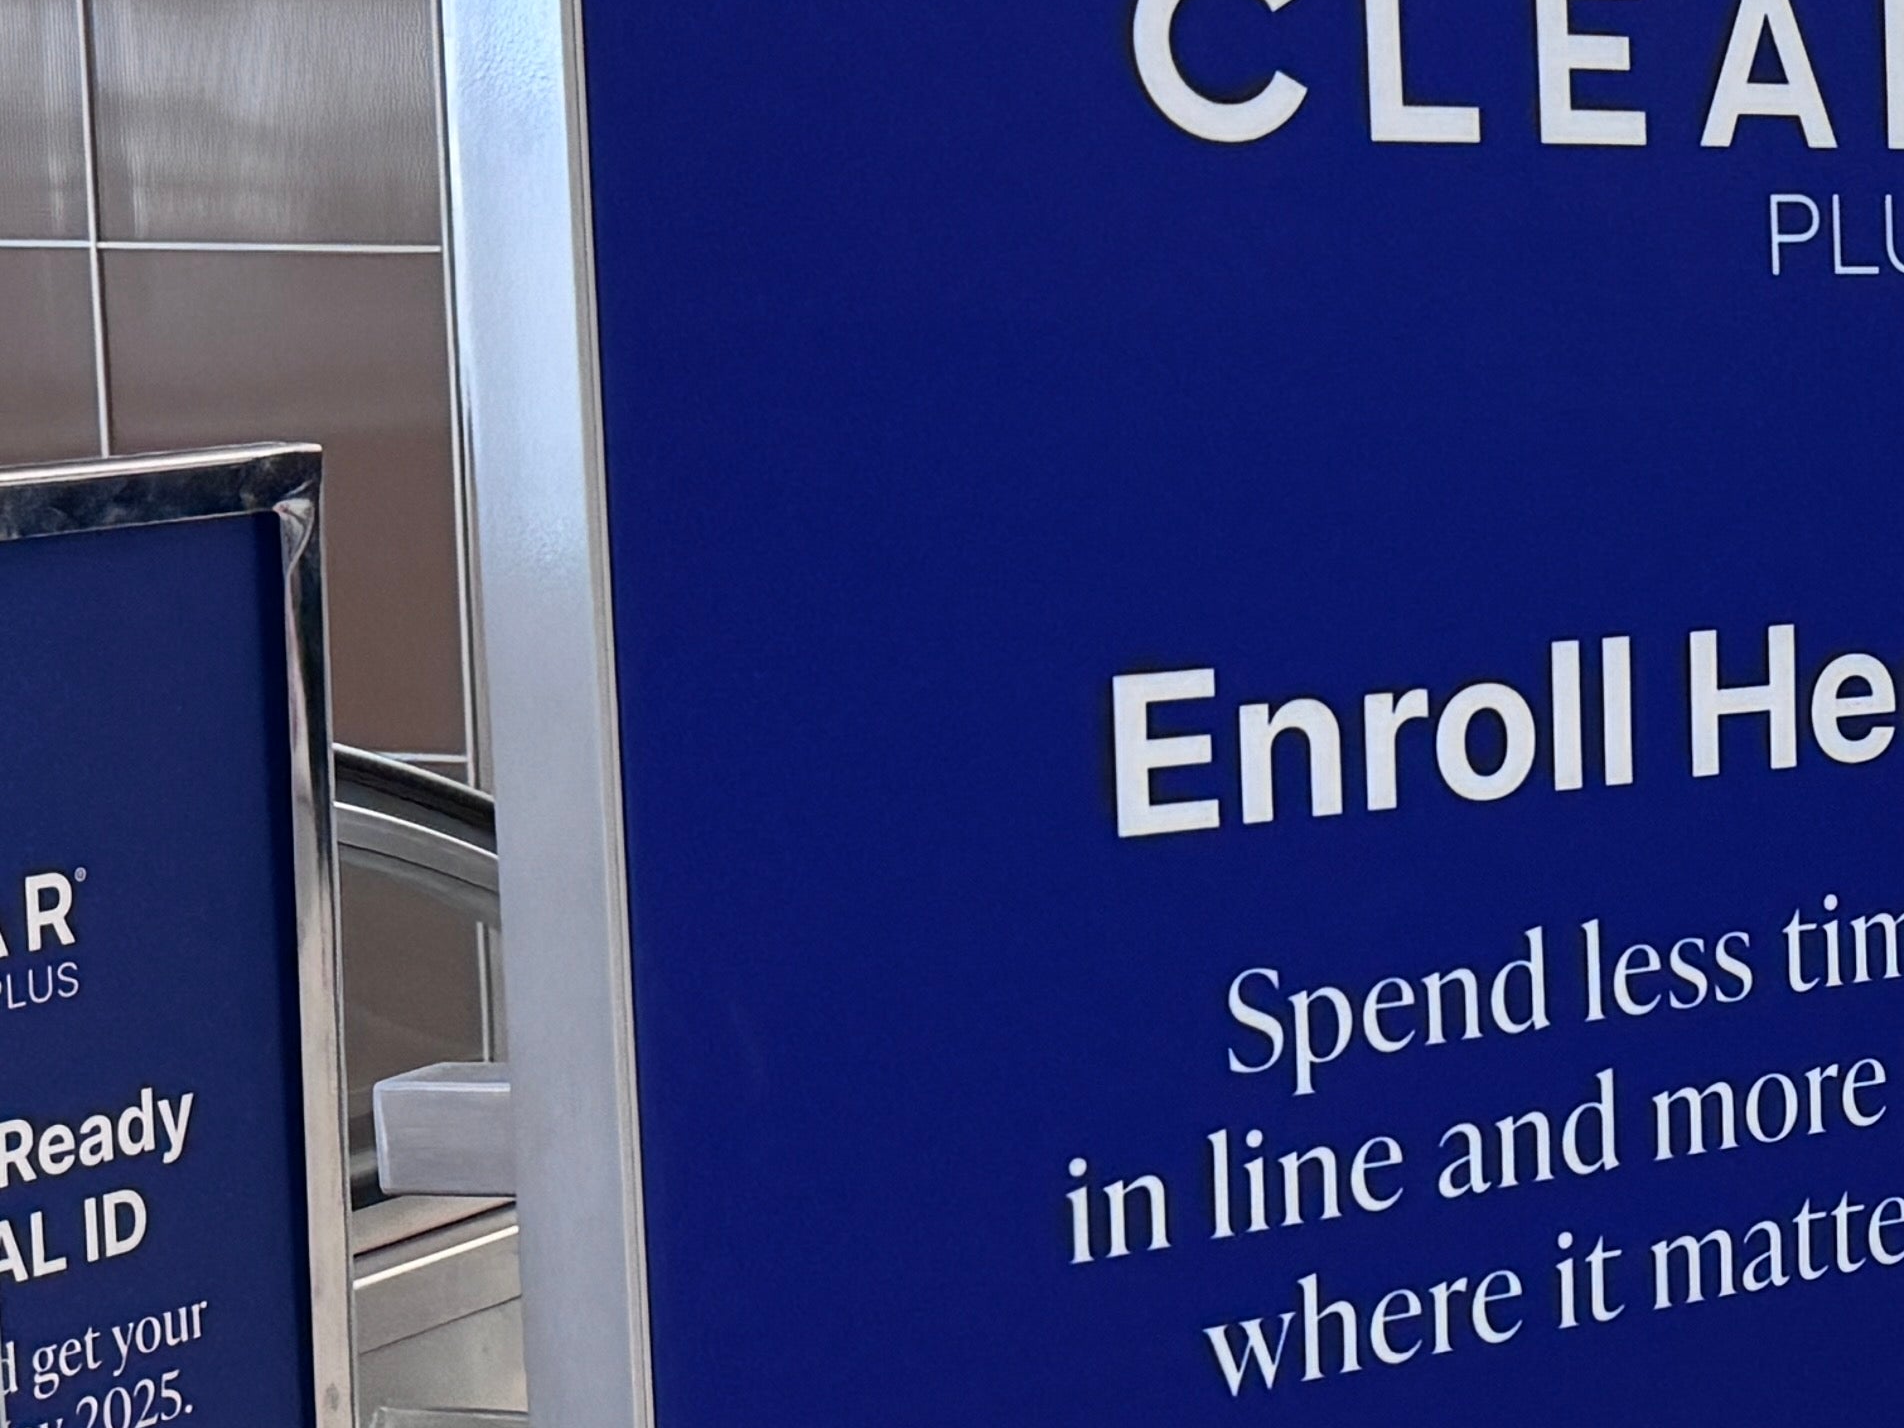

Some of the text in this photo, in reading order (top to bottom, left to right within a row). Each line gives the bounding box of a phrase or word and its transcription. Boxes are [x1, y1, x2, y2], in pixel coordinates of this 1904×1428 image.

[1113, 636, 1632, 837] Enroll
[0, 962, 79, 1009] LUS
[1229, 927, 1549, 1095] Spend
[1582, 919, 1752, 1020] less
[0, 1087, 193, 1188] Ready
[1067, 1158, 1170, 1263] in
[1208, 1130, 1402, 1238] line
[1439, 1069, 1619, 1197] and
[1653, 1059, 1885, 1160] more
[0, 1189, 147, 1282] AL ID
[32, 1327, 102, 1400] get
[112, 1301, 207, 1376] your
[1205, 1271, 1522, 1396] where
[1557, 1232, 1624, 1328] it
